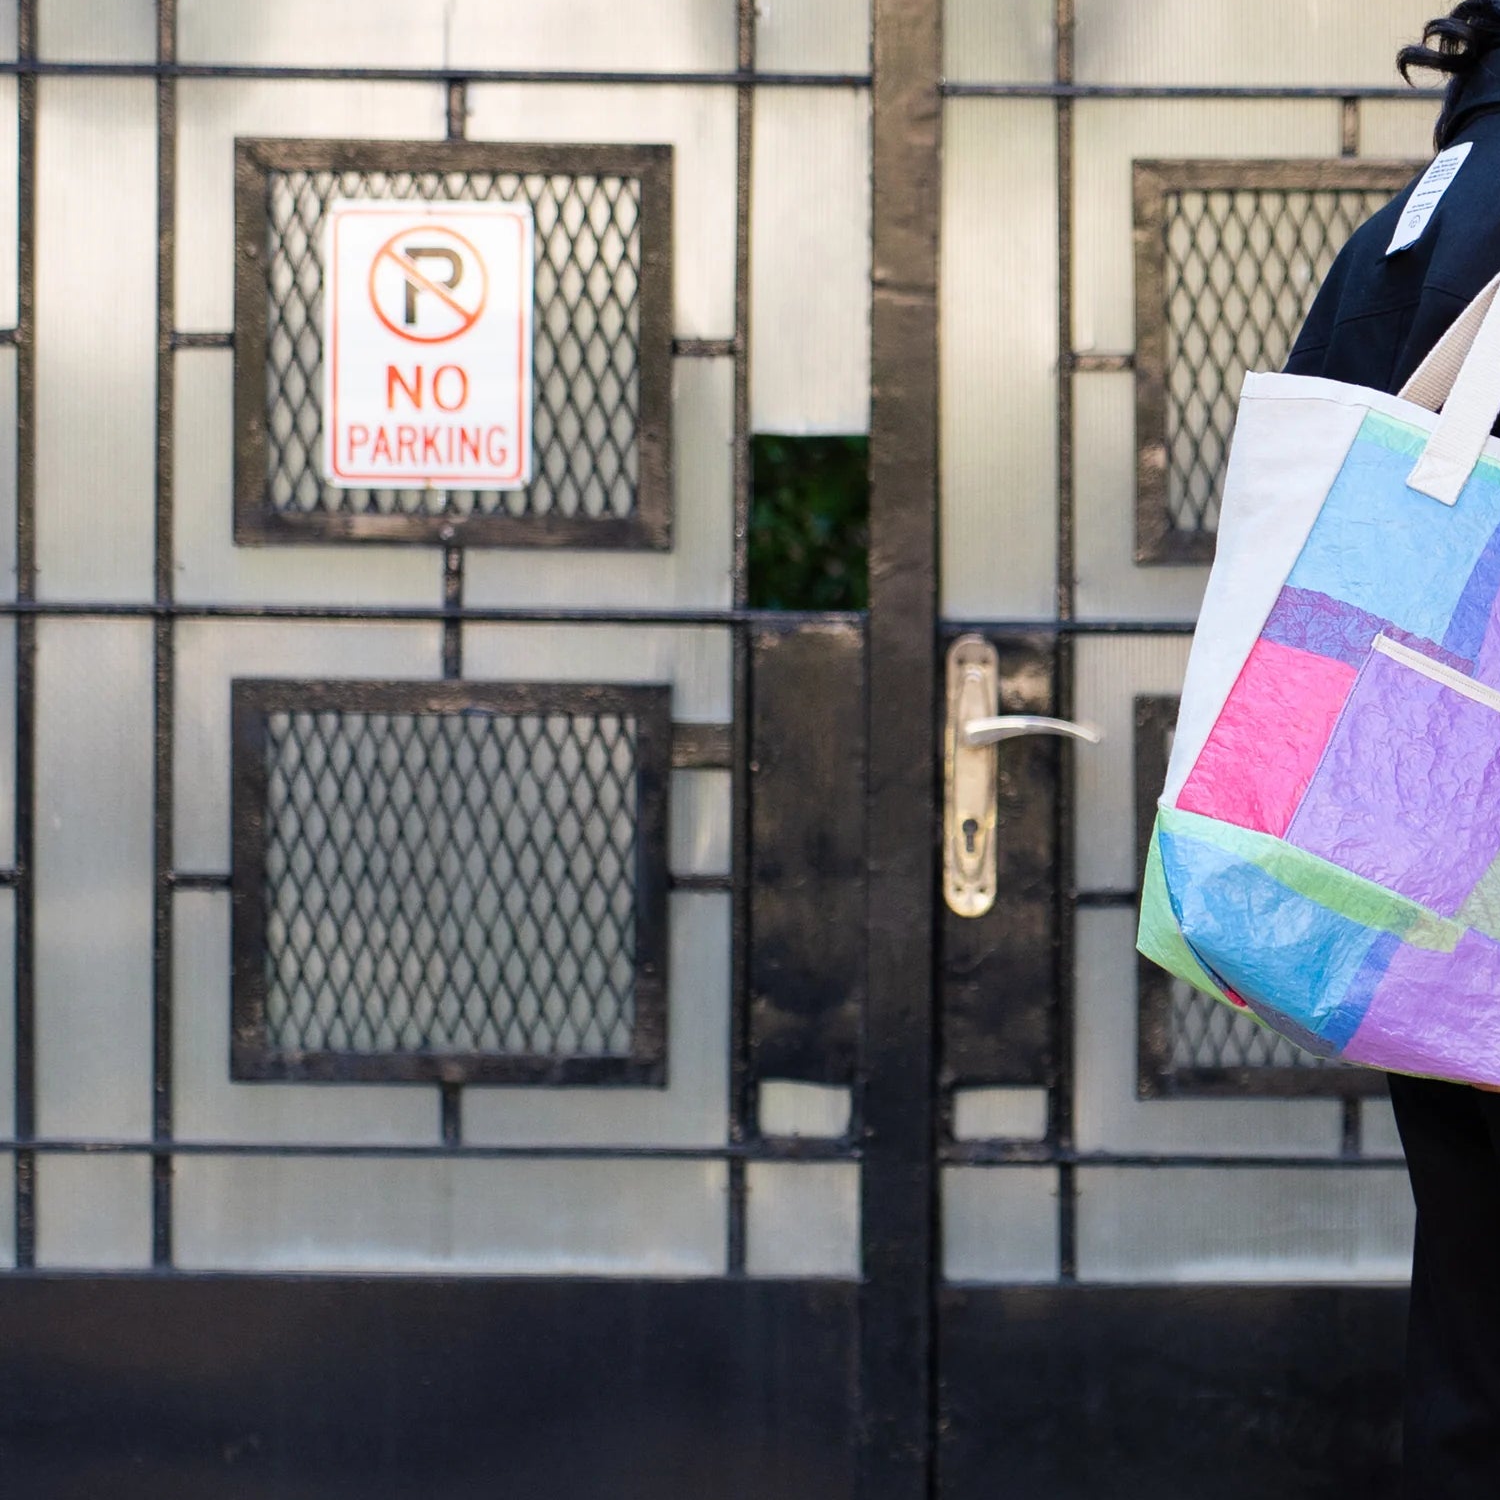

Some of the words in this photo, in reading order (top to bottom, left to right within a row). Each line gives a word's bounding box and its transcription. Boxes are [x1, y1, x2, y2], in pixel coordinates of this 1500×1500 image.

[404, 247, 465, 326] P
[387, 364, 469, 412] NO
[347, 424, 508, 468] PARKING
